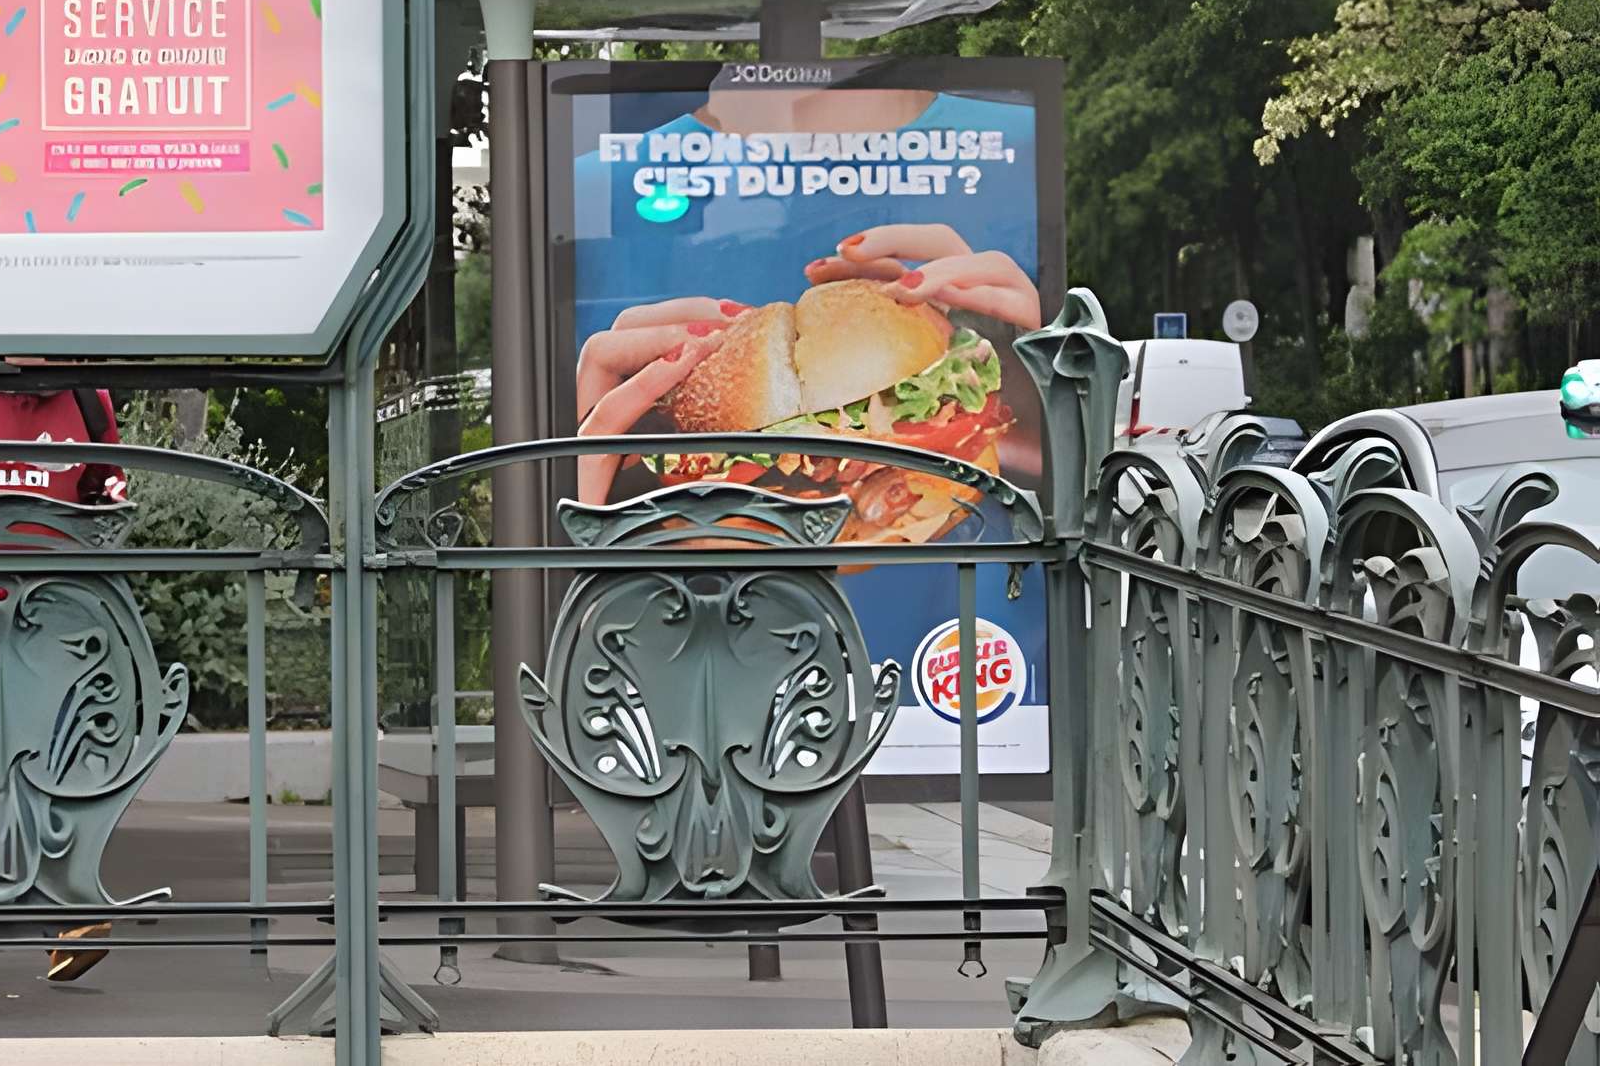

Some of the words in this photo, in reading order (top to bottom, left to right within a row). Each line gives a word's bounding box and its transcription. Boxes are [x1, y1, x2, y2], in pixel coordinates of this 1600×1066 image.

[63, 75, 230, 116] GRATUIT
[599, 133, 644, 163] ET
[649, 131, 744, 164] MON
[746, 129, 1016, 164] STEAKHOUSE,
[633, 165, 733, 197] C'EST
[737, 165, 796, 197] DU
[801, 164, 952, 197] POULET
